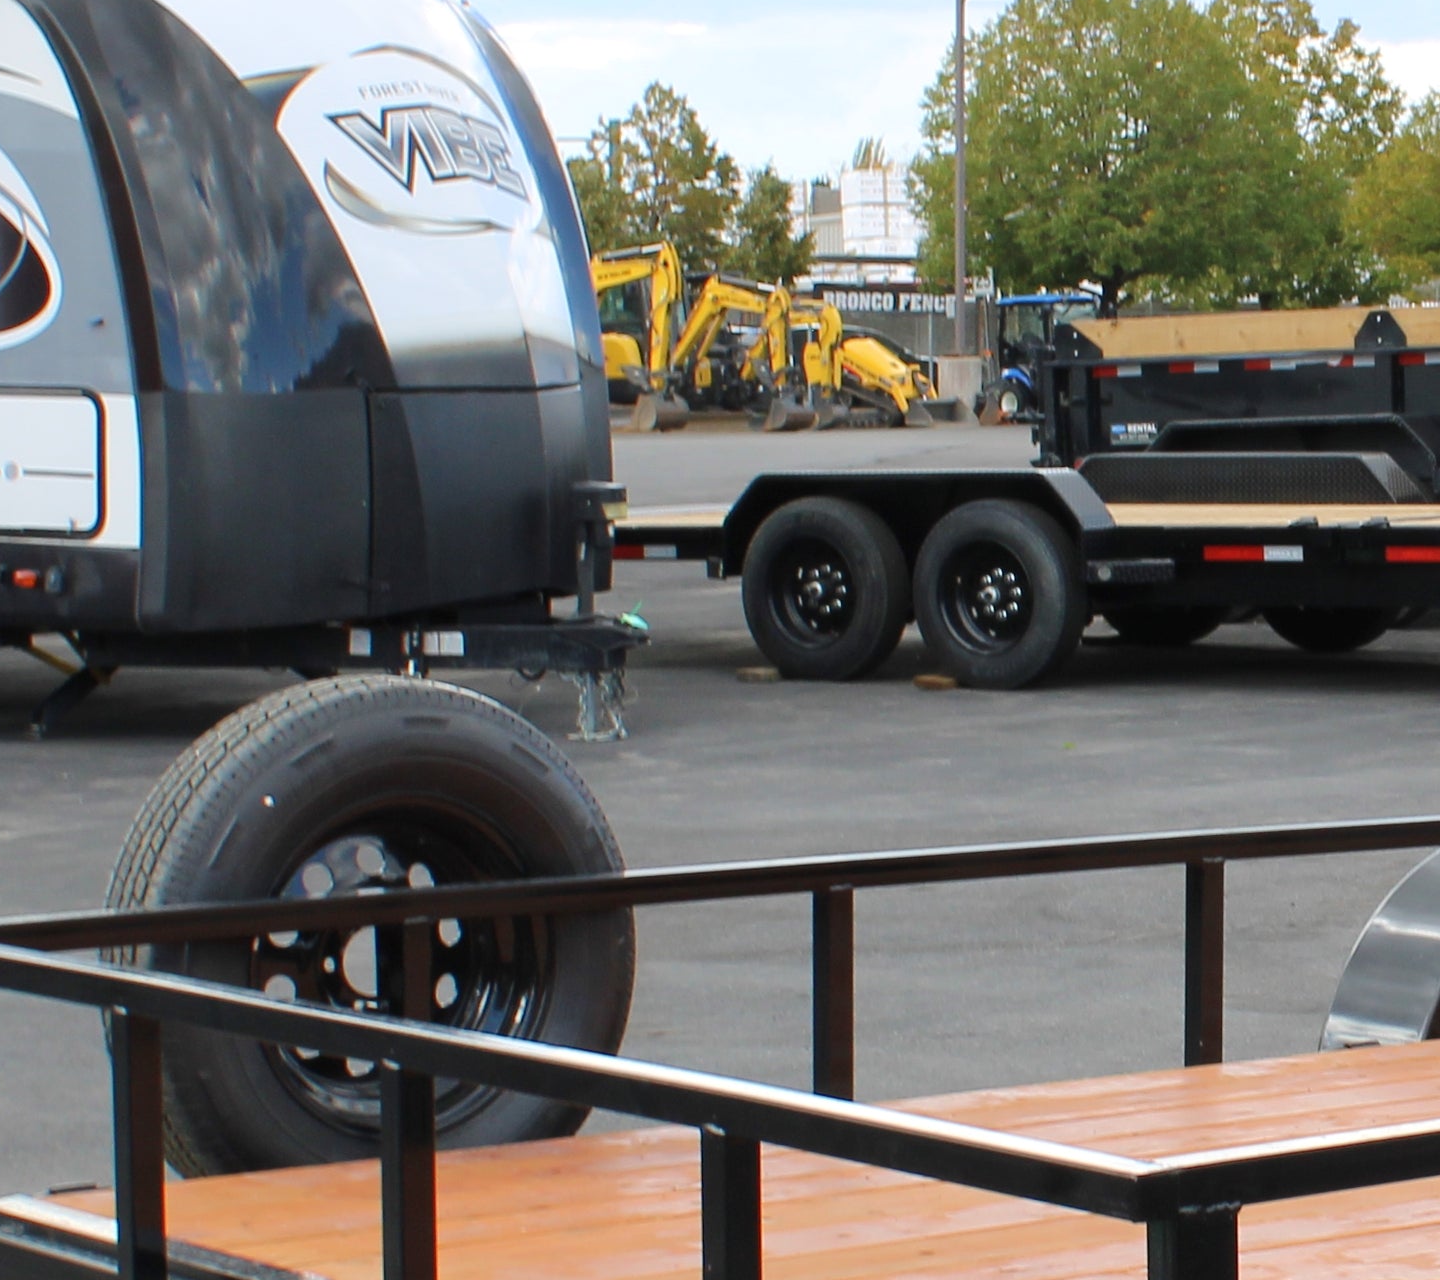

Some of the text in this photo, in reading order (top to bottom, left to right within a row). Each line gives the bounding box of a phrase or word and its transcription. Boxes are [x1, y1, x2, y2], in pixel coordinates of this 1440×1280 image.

[358, 79, 423, 101] FOREST
[324, 103, 530, 204] VIBE
[823, 290, 894, 312] BRONCO
